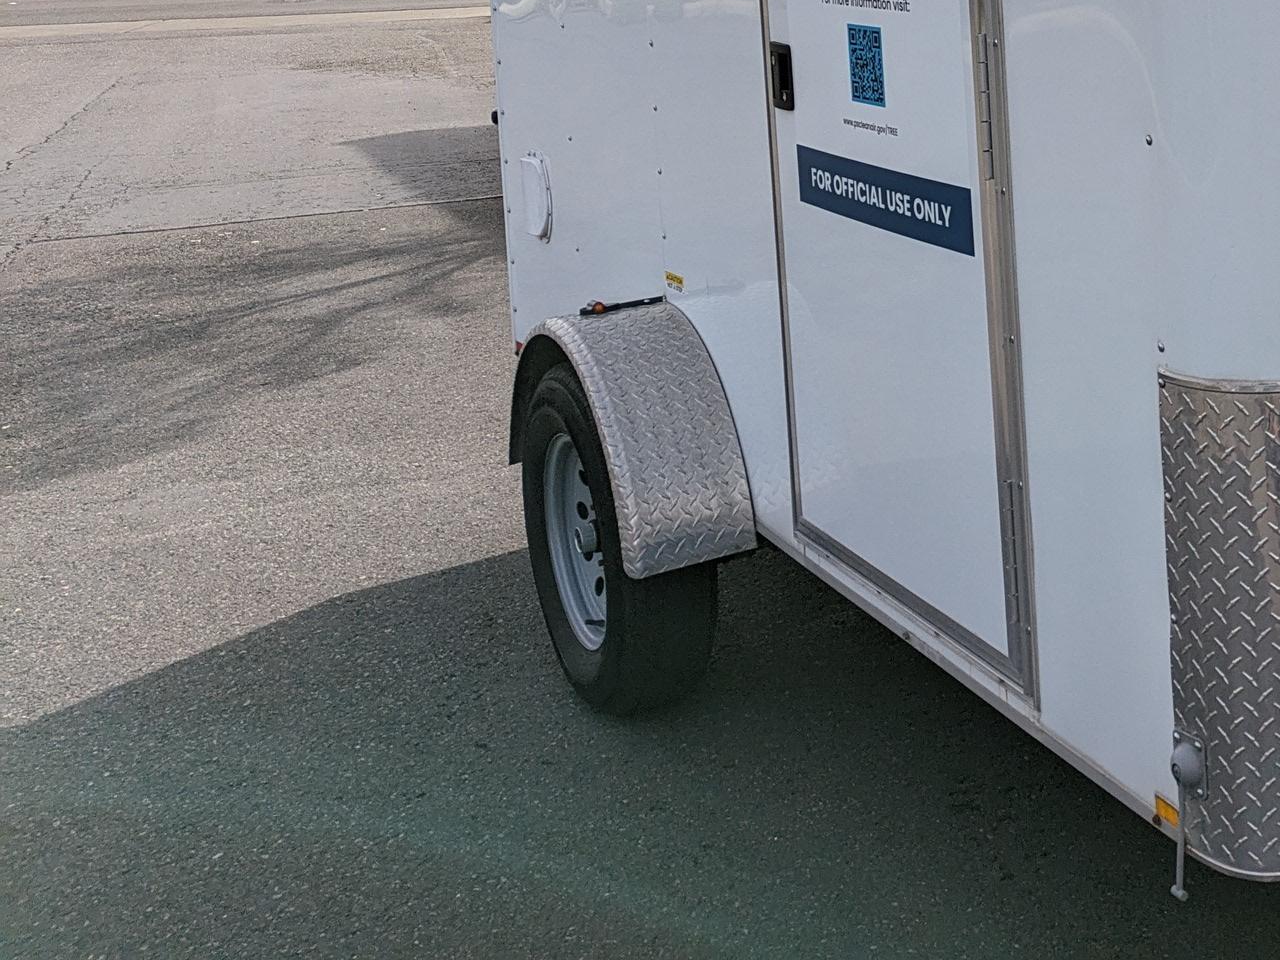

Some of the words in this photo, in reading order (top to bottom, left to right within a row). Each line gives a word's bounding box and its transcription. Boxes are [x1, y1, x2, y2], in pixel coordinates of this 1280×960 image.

[811, 167, 833, 192] FOR
[833, 175, 885, 210] OFFICIAL
[886, 190, 912, 218] USE
[913, 197, 952, 228] ONLY
